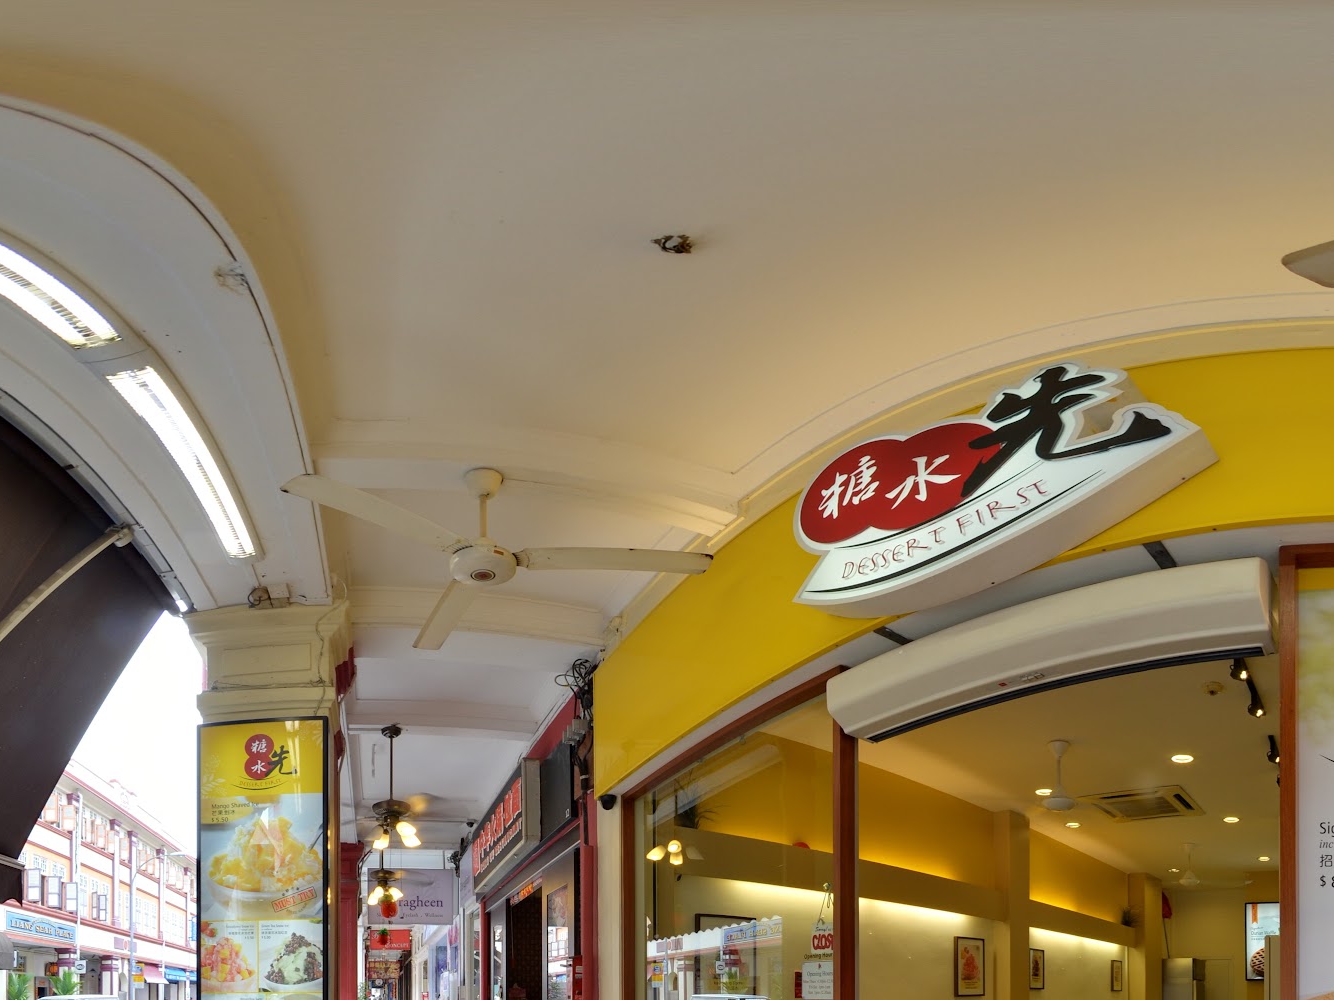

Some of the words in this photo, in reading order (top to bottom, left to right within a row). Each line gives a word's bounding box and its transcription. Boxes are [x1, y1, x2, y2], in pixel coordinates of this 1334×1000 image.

[960, 365, 1172, 499] 先
[818, 454, 962, 519] 糖水
[842, 527, 944, 580] DESSERT
[957, 479, 1052, 537] FIRST
[251, 739, 267, 774] 糖水
[265, 745, 298, 777] 先
[273, 894, 296, 911] MUST
[297, 888, 316, 902] TRY
[10, 919, 33, 931] LIANG
[35, 925, 53, 936] SEAH
[54, 928, 73, 939] PLACE
